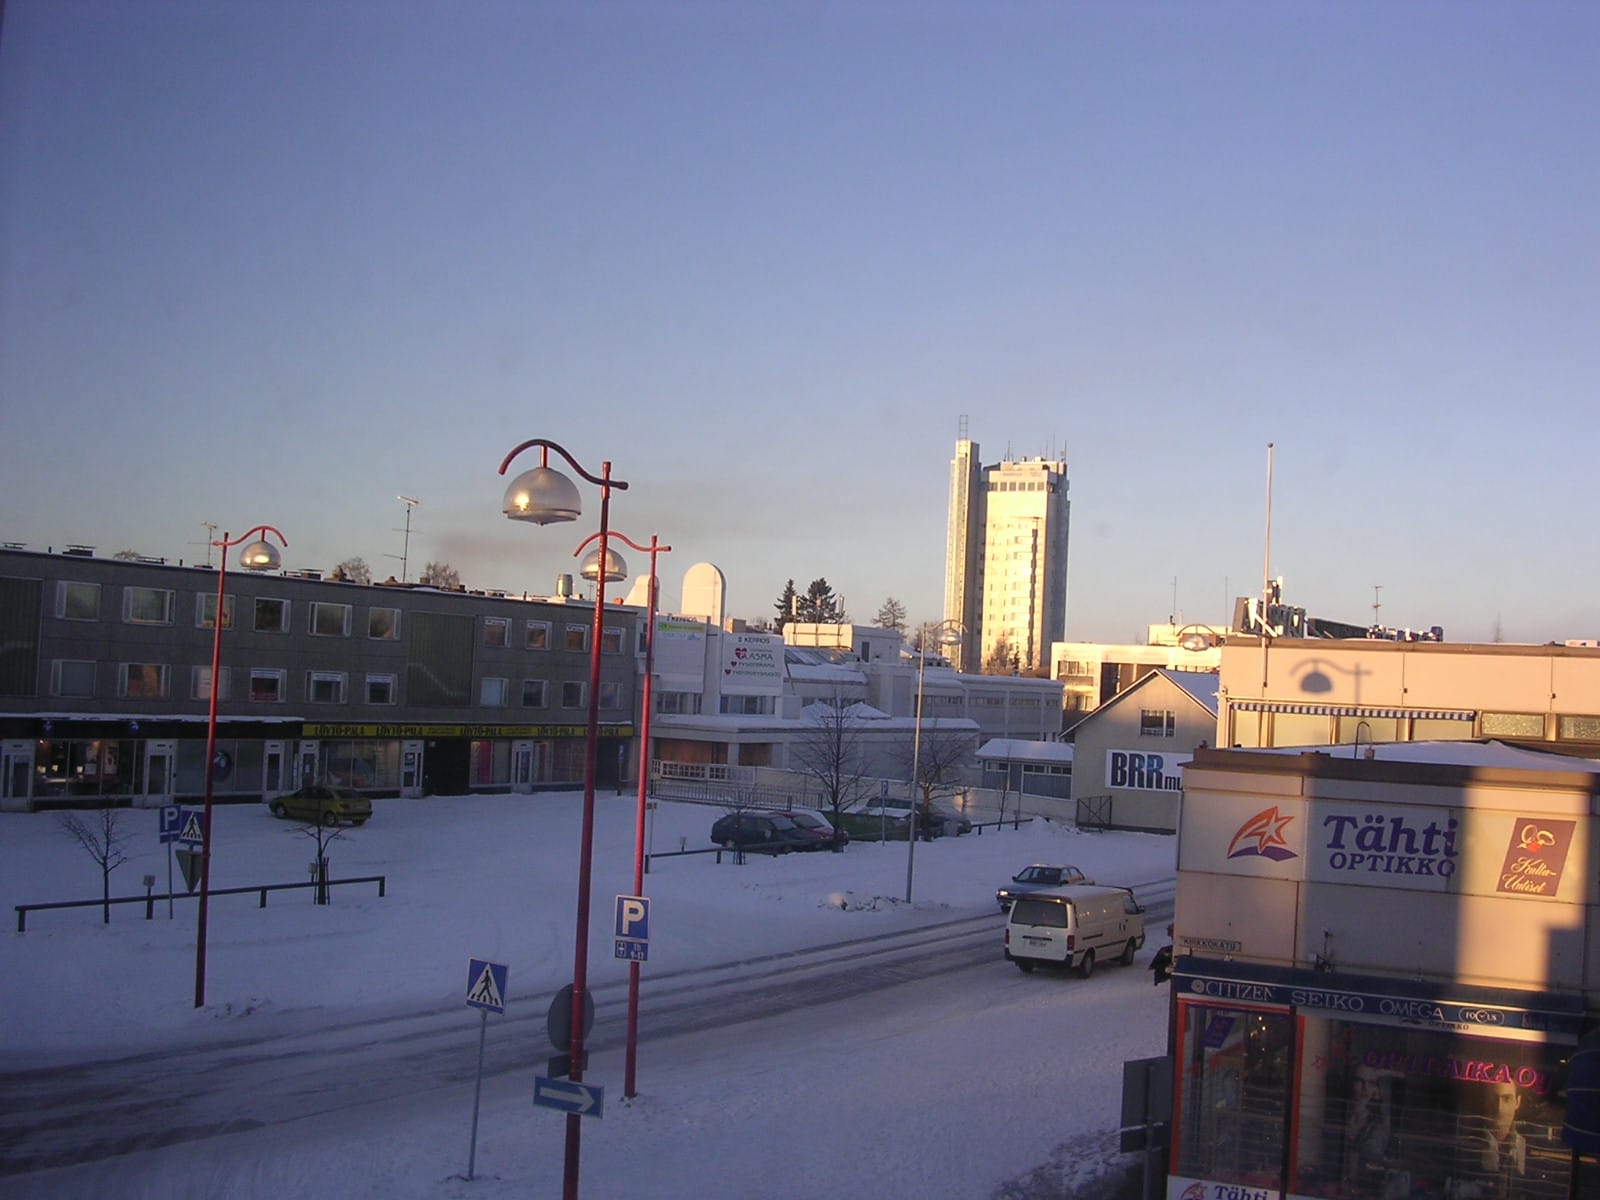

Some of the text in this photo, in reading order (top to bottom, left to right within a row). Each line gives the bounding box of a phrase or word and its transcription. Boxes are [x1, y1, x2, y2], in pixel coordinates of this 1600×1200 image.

[164, 807, 178, 830] P
[1323, 814, 1458, 857] Tähti
[1329, 852, 1456, 877] OPTIKKO
[622, 900, 645, 935] P
[1206, 981, 1276, 1000] CITIZEN
[1291, 990, 1364, 1011] SEIKO
[1380, 999, 1444, 1020] OMEGA
